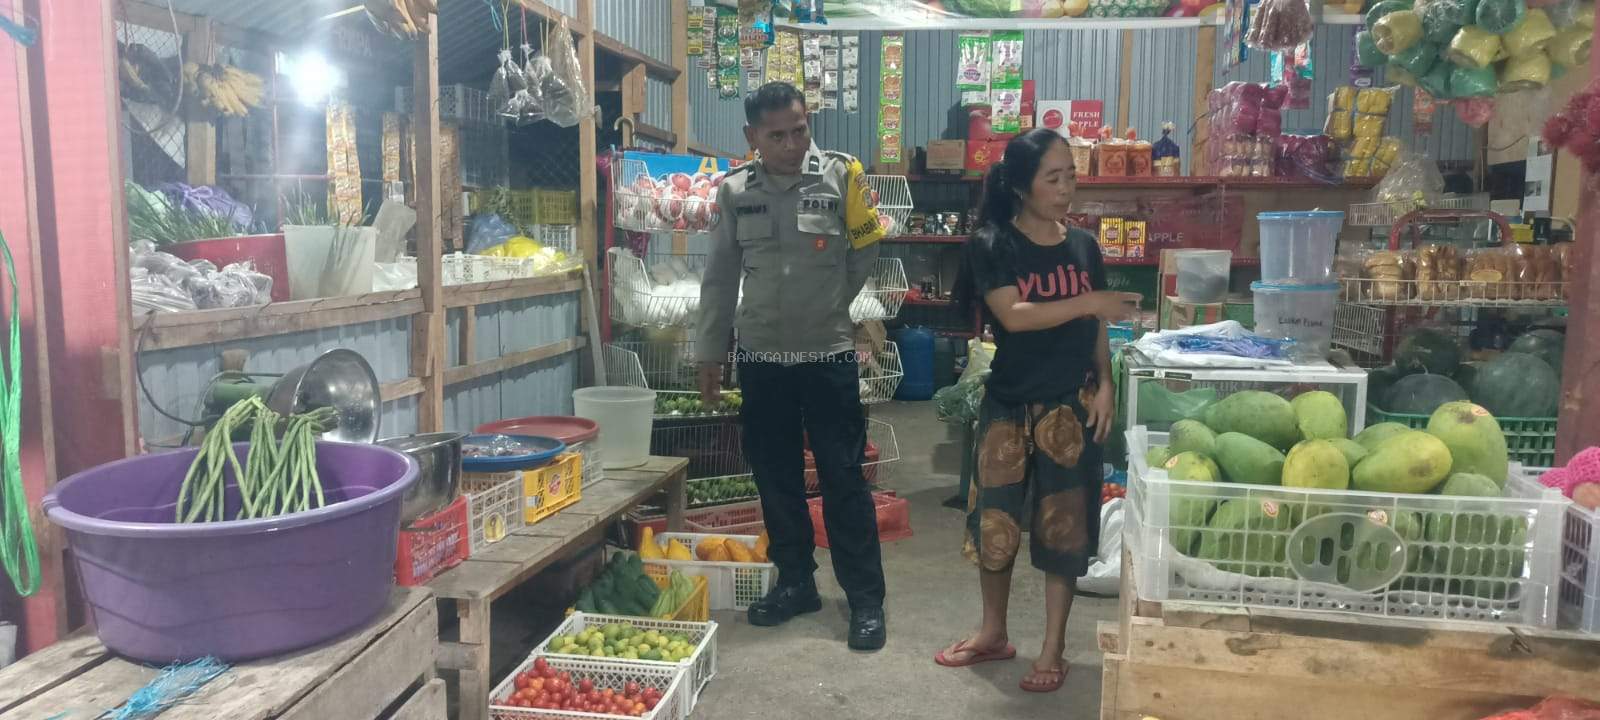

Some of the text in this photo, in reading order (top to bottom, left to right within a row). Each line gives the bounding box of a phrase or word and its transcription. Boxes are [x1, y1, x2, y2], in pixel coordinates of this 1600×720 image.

[1073, 111, 1100, 119] FRESH
[1076, 120, 1099, 128] PPLE
[1017, 264, 1092, 303] yulis
